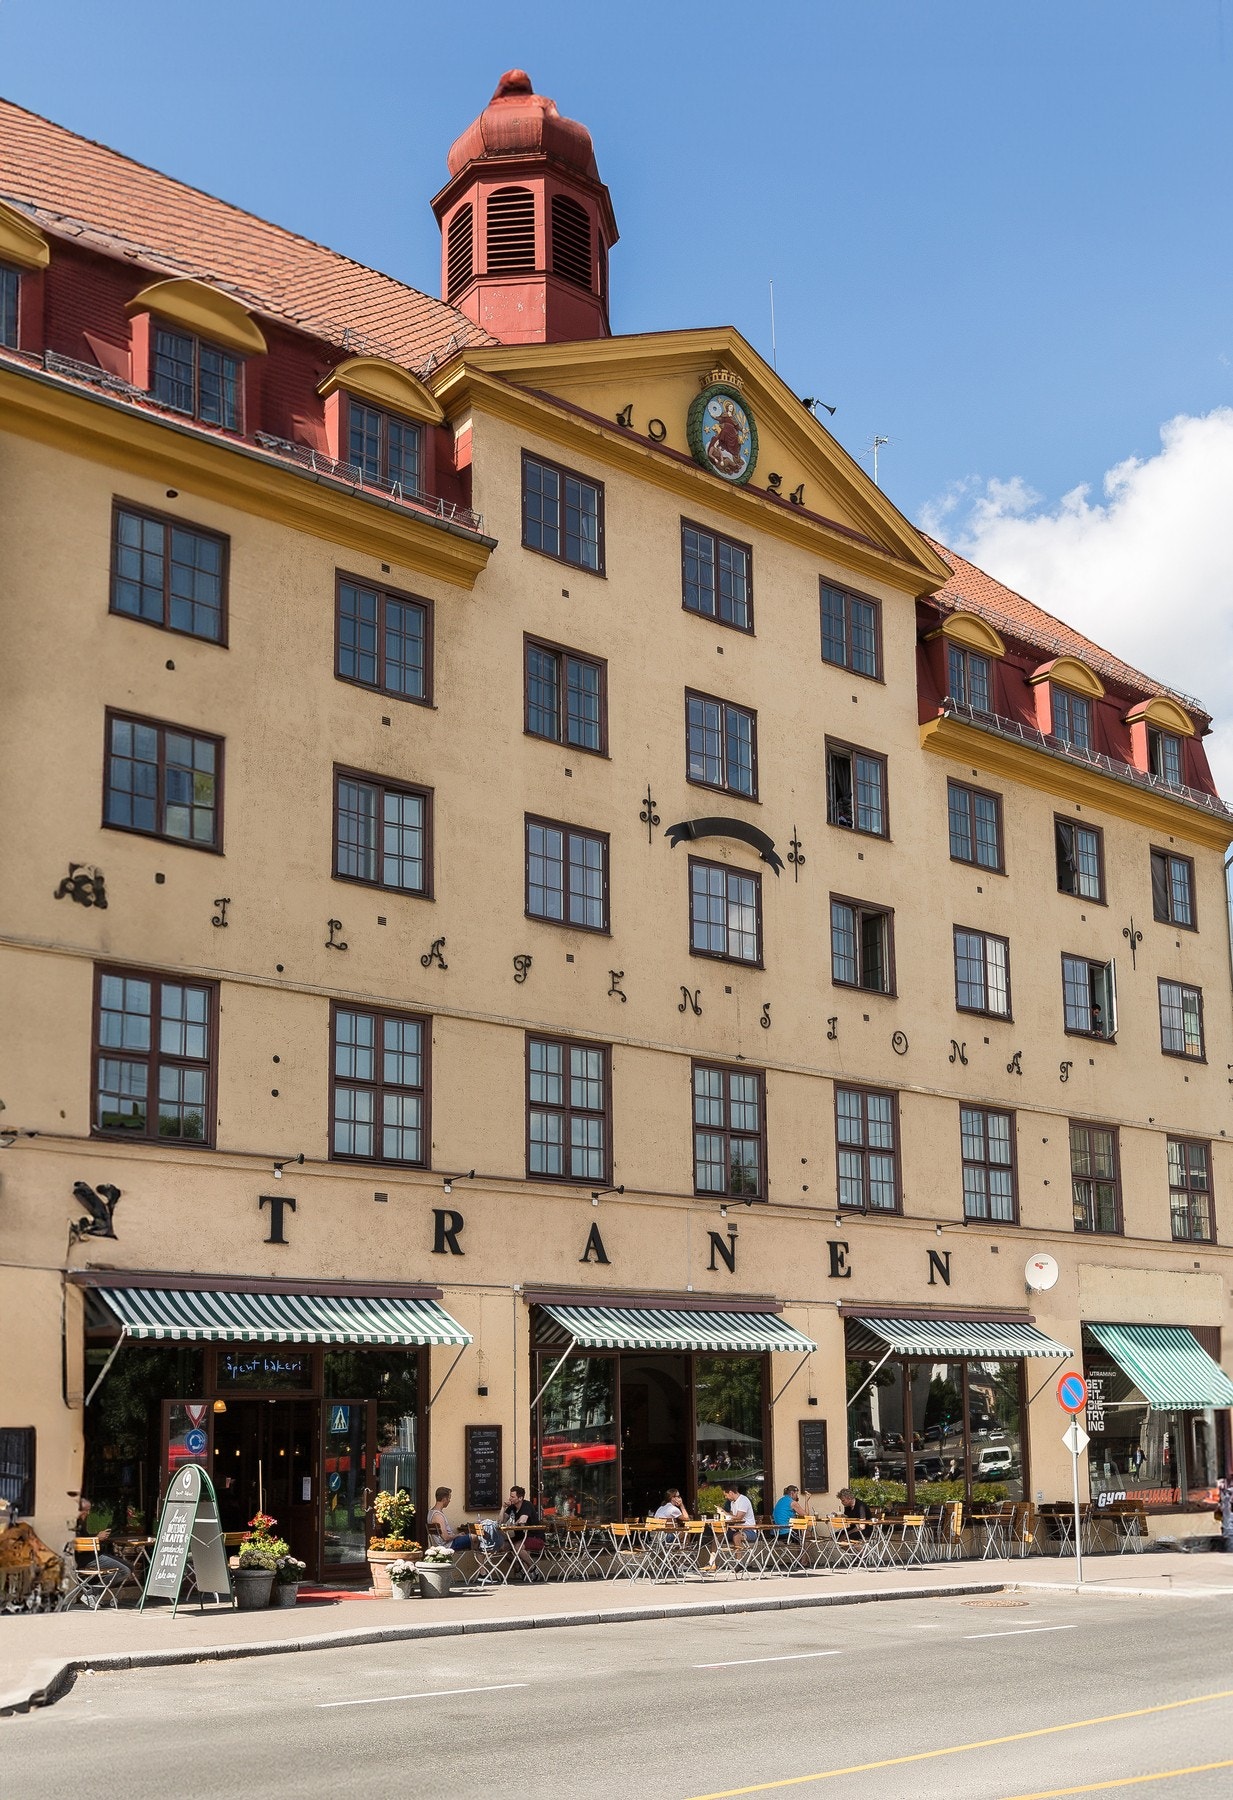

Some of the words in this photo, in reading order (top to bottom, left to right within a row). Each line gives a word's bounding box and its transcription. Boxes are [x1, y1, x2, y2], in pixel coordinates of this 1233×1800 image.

[258, 1196, 952, 1286] TRANEN
[227, 1356, 260, 1379] åpent
[264, 1359, 302, 1373] bakeri
[1086, 1379, 1103, 1389] GET
[1087, 1390, 1100, 1400] FIT
[1087, 1400, 1103, 1410] DIE
[1087, 1411, 1105, 1420] TRY
[1088, 1421, 1105, 1431] ING
